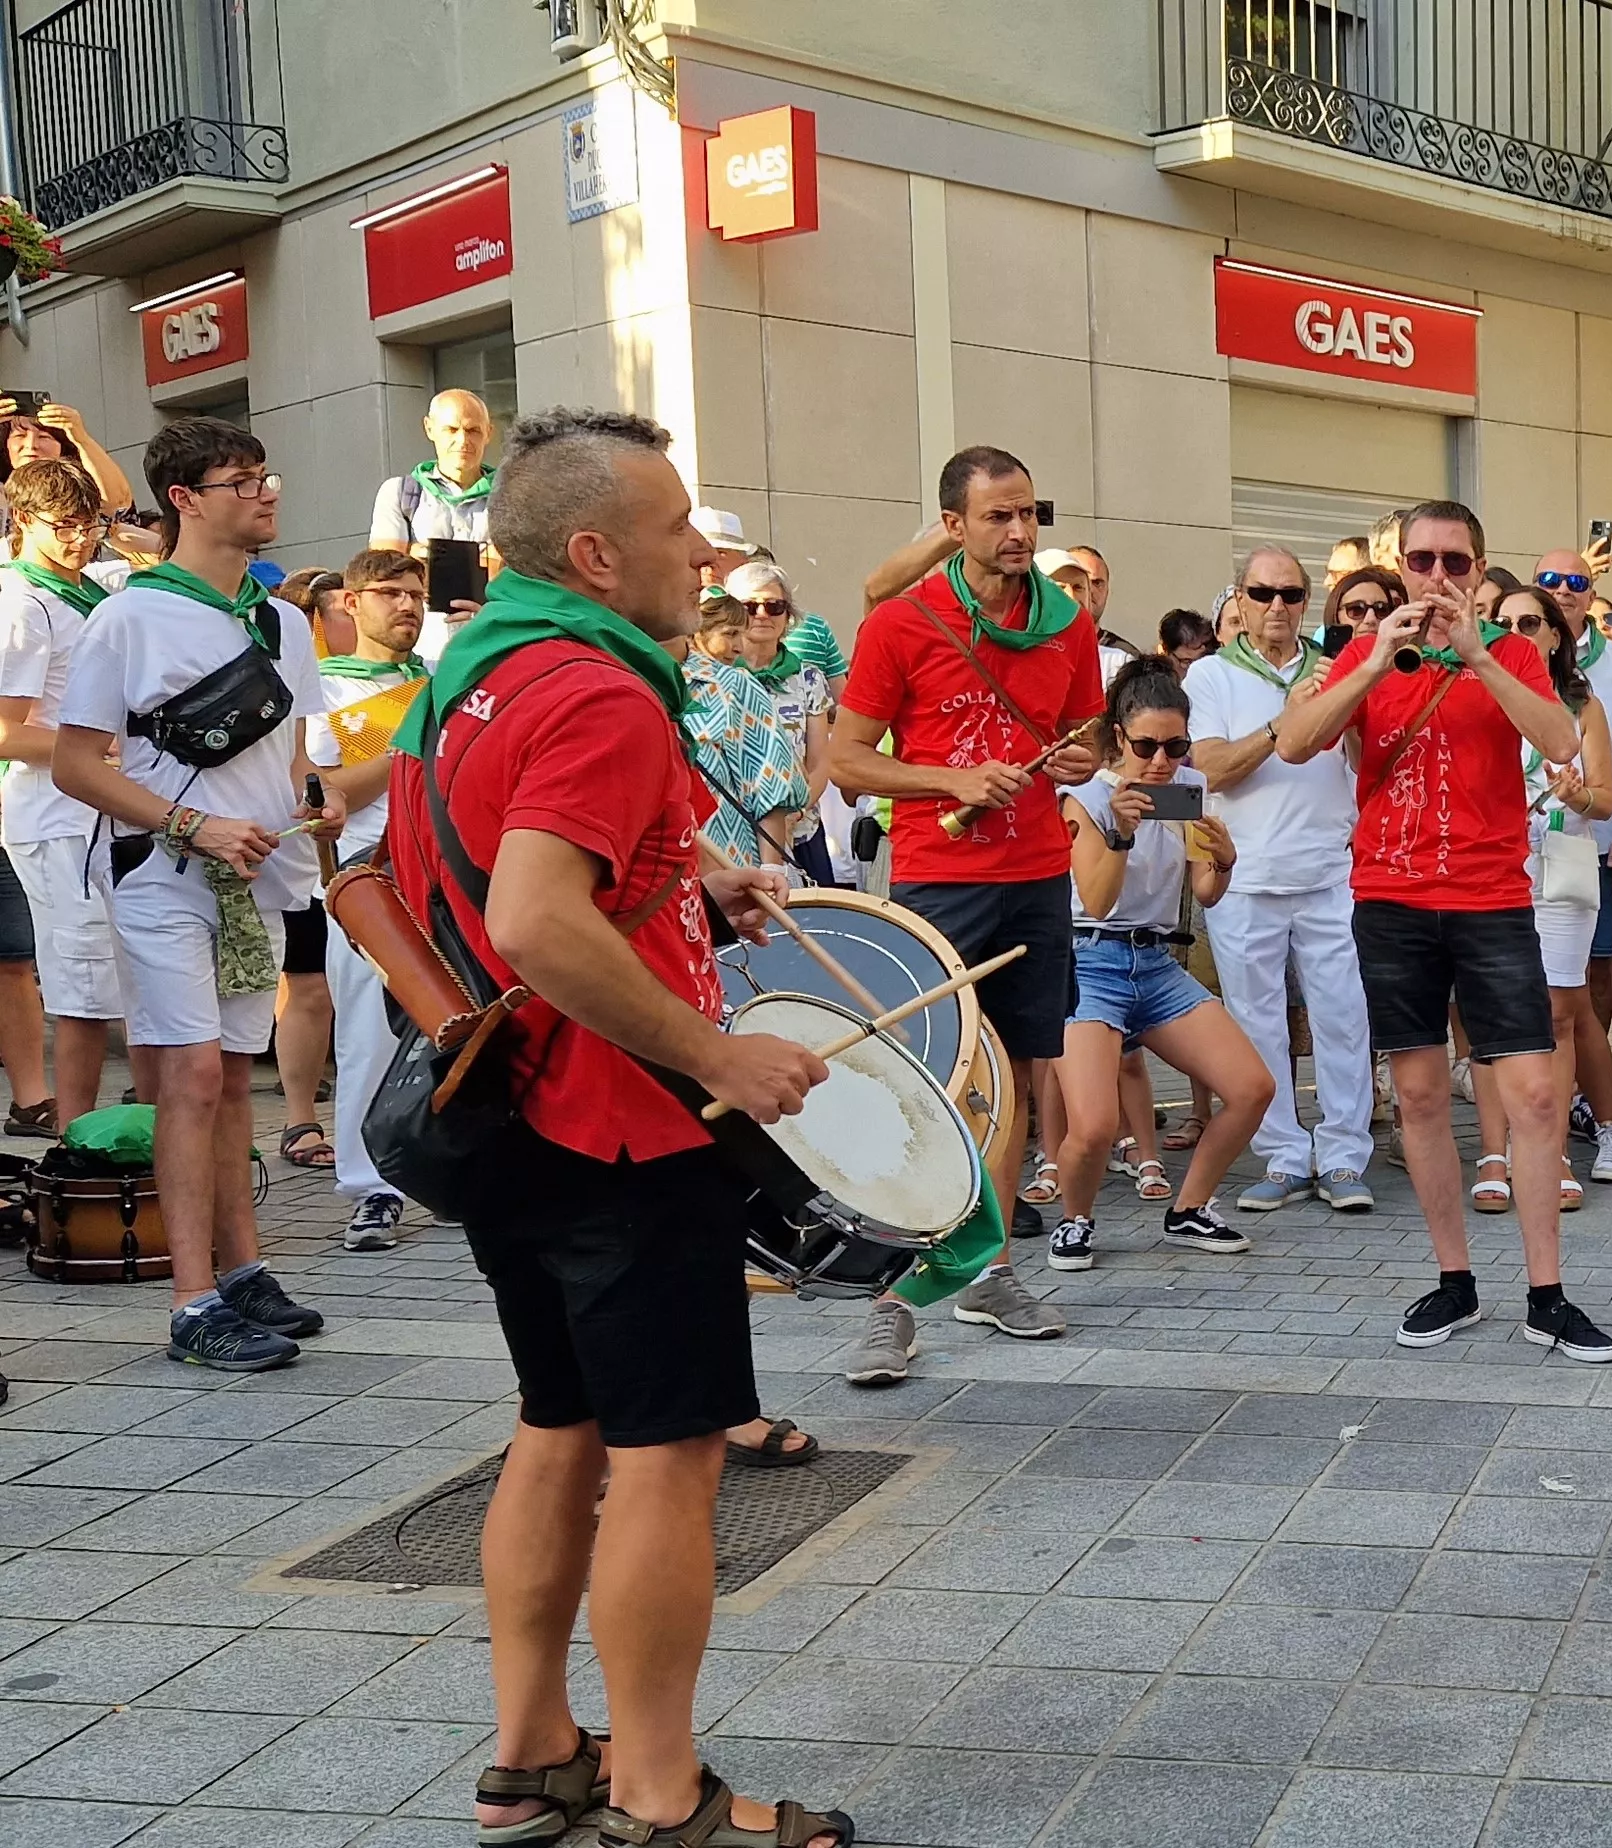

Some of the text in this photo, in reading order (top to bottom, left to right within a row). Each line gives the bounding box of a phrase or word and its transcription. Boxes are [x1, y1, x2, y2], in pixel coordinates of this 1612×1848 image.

[726, 144, 788, 188] GAES
[455, 238, 505, 271] amplifon
[162, 302, 220, 363] GAES
[1294, 300, 1415, 368] GAES
[940, 690, 997, 713] COLLA
[1378, 726, 1432, 748] COA
